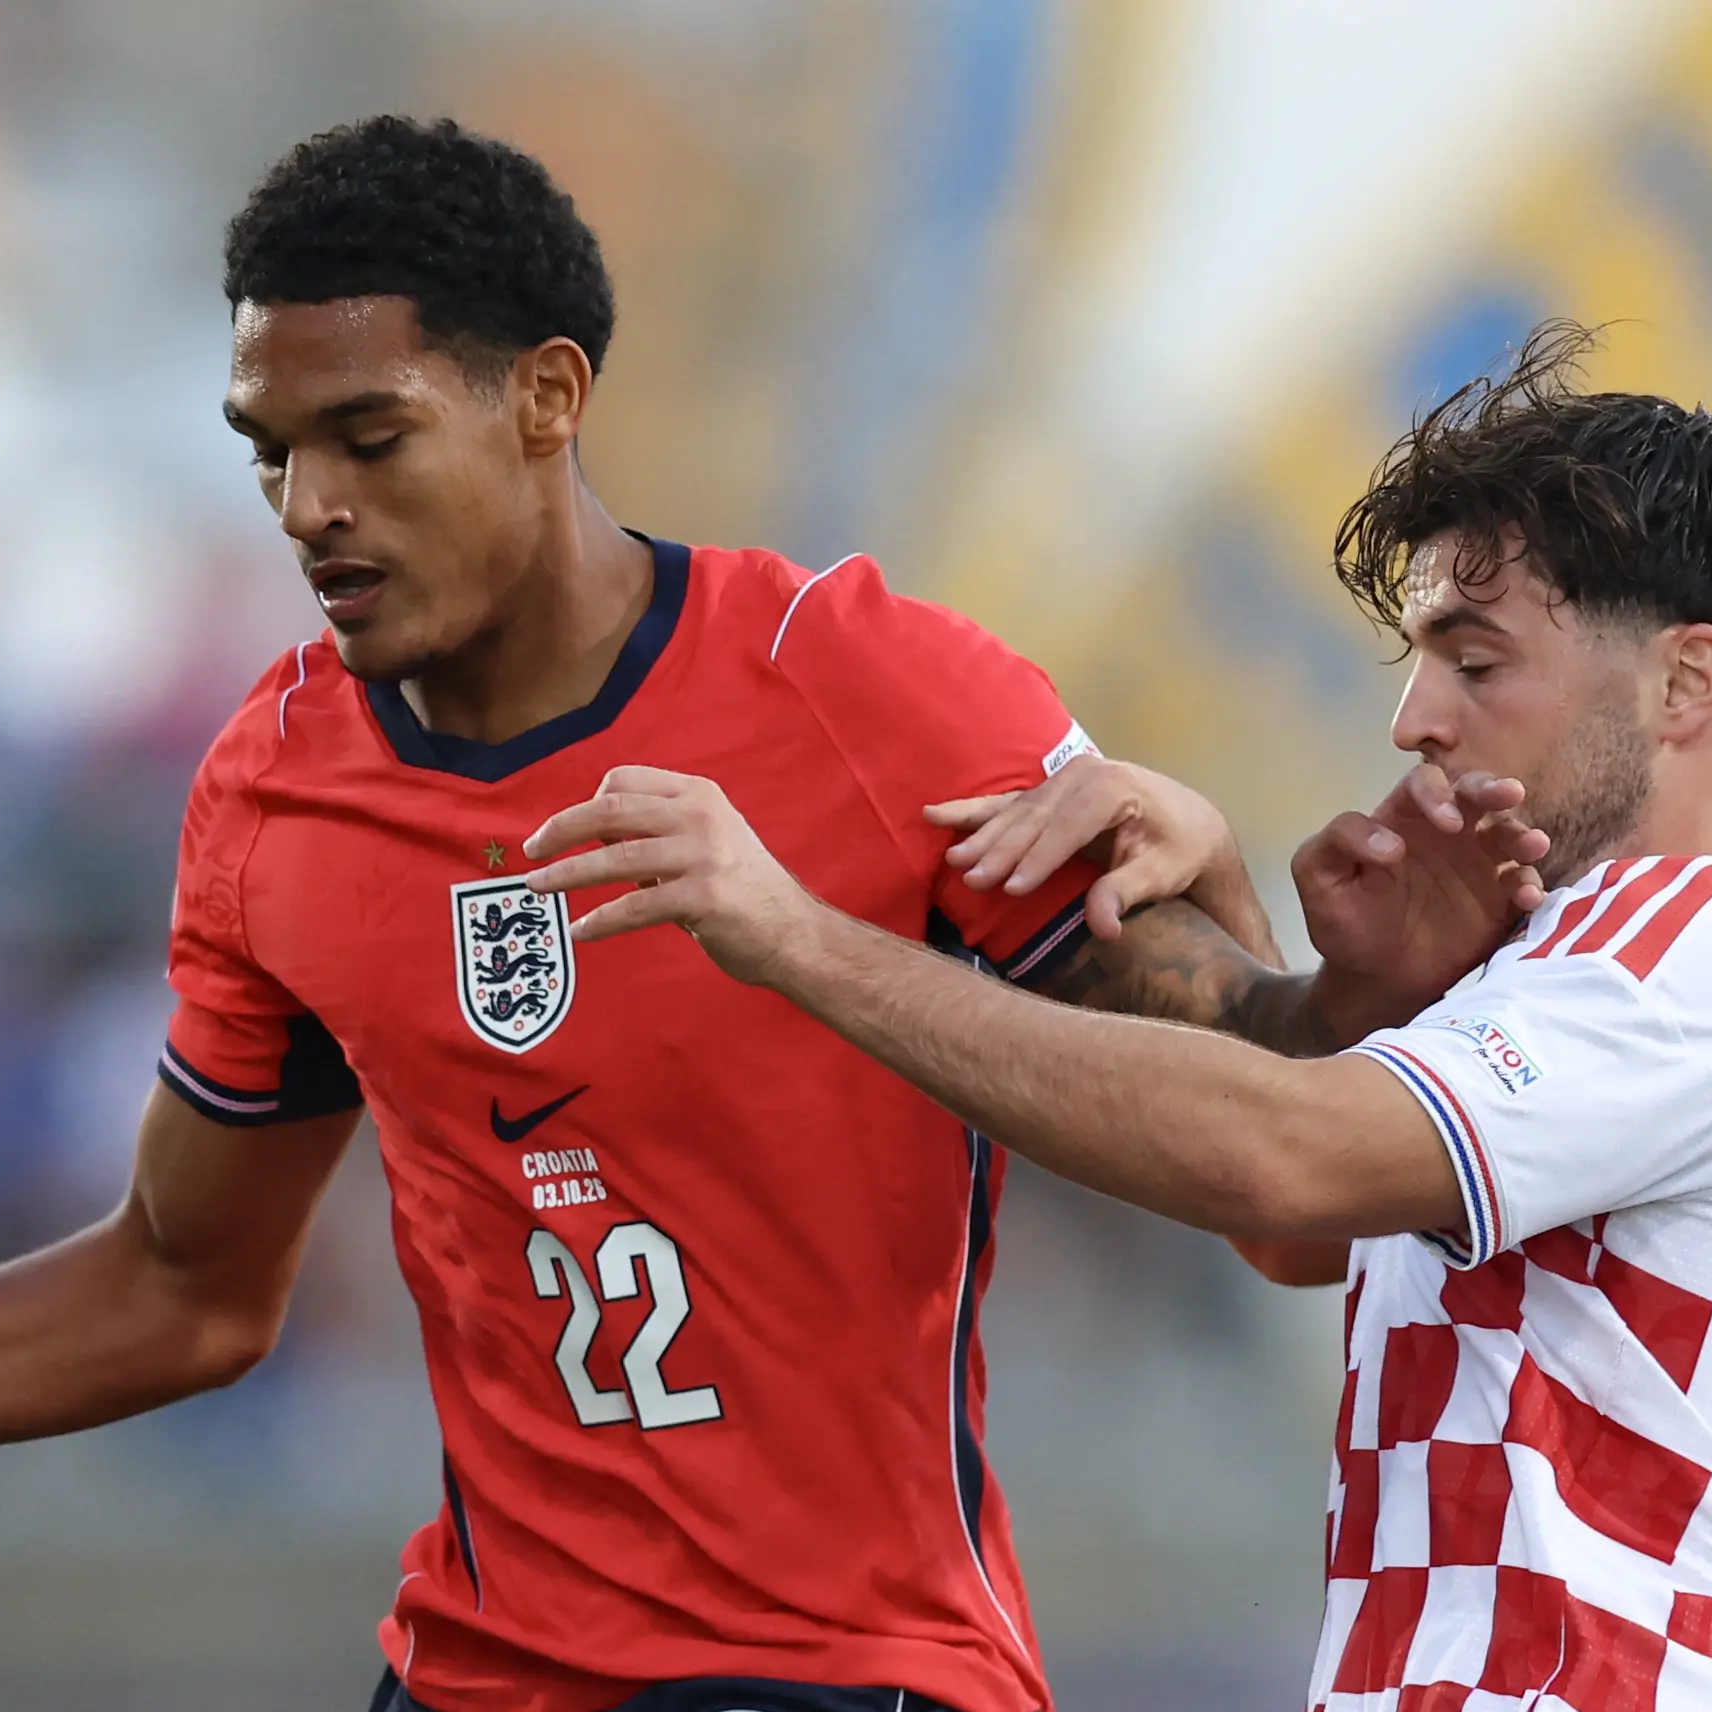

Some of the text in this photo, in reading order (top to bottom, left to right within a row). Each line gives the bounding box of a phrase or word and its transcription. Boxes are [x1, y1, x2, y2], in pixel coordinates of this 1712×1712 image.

[1472, 1048, 1517, 1095] for children
[521, 1147, 600, 1179] CROATIA
[532, 1178, 607, 1210] 03.10.26
[524, 1220, 724, 1431] 22
